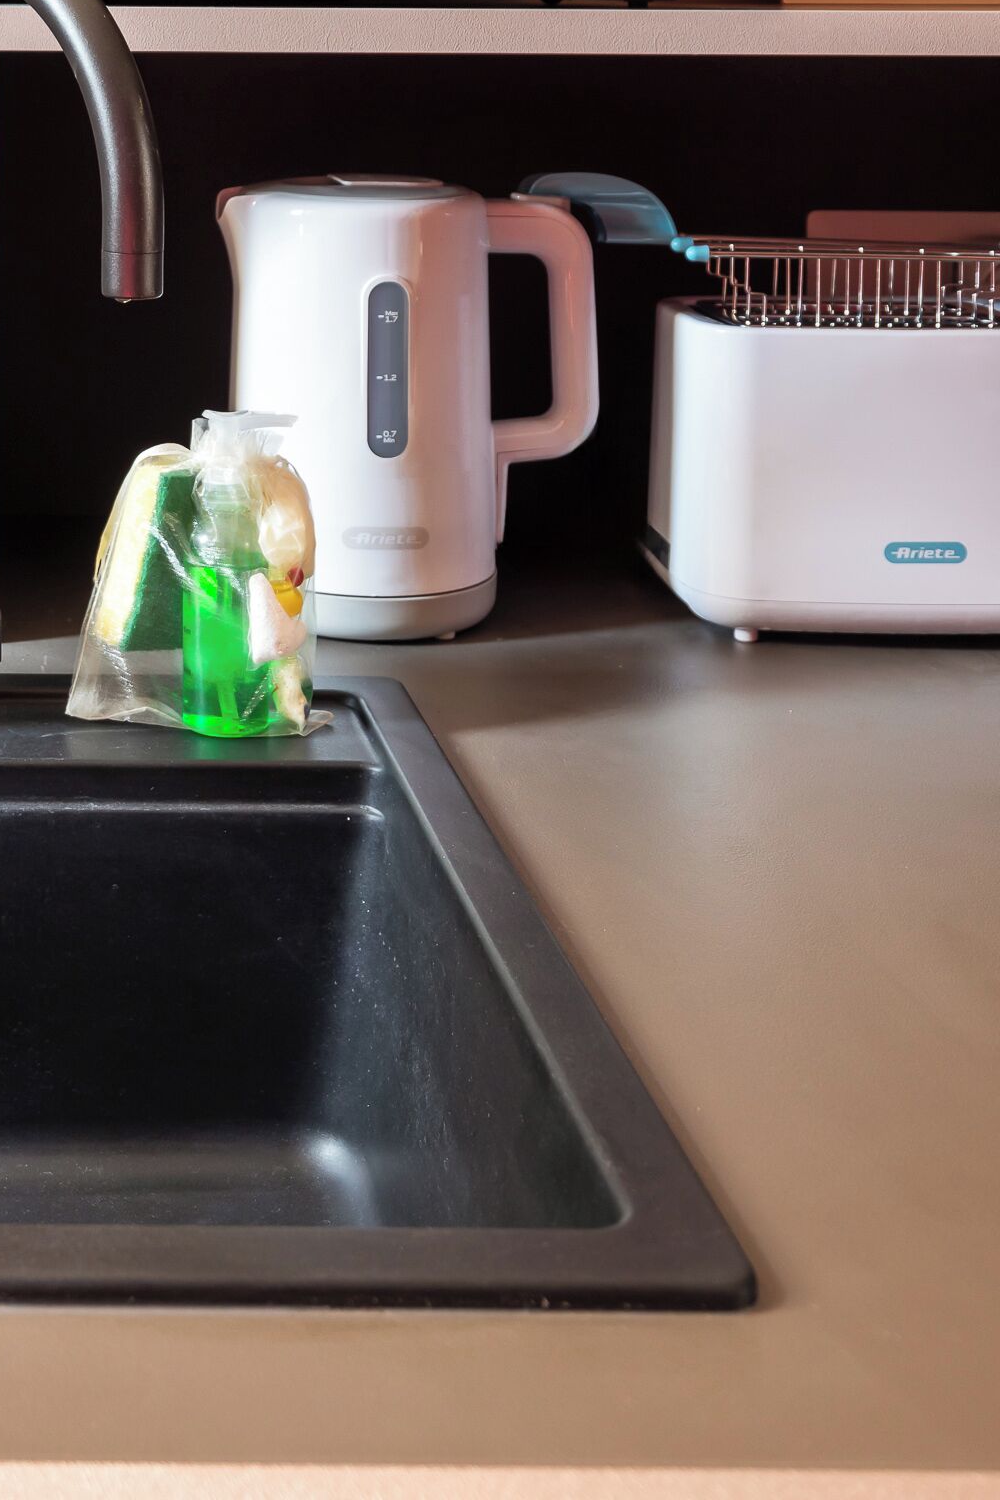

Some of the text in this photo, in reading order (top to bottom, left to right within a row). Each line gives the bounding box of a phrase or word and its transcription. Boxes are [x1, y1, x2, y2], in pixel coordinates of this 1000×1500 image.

[385, 315, 398, 323] 1.7
[384, 374, 398, 382] 1.2
[383, 430, 397, 438] 0.7
[350, 531, 422, 546] Ariete
[891, 546, 961, 559] Ariete
